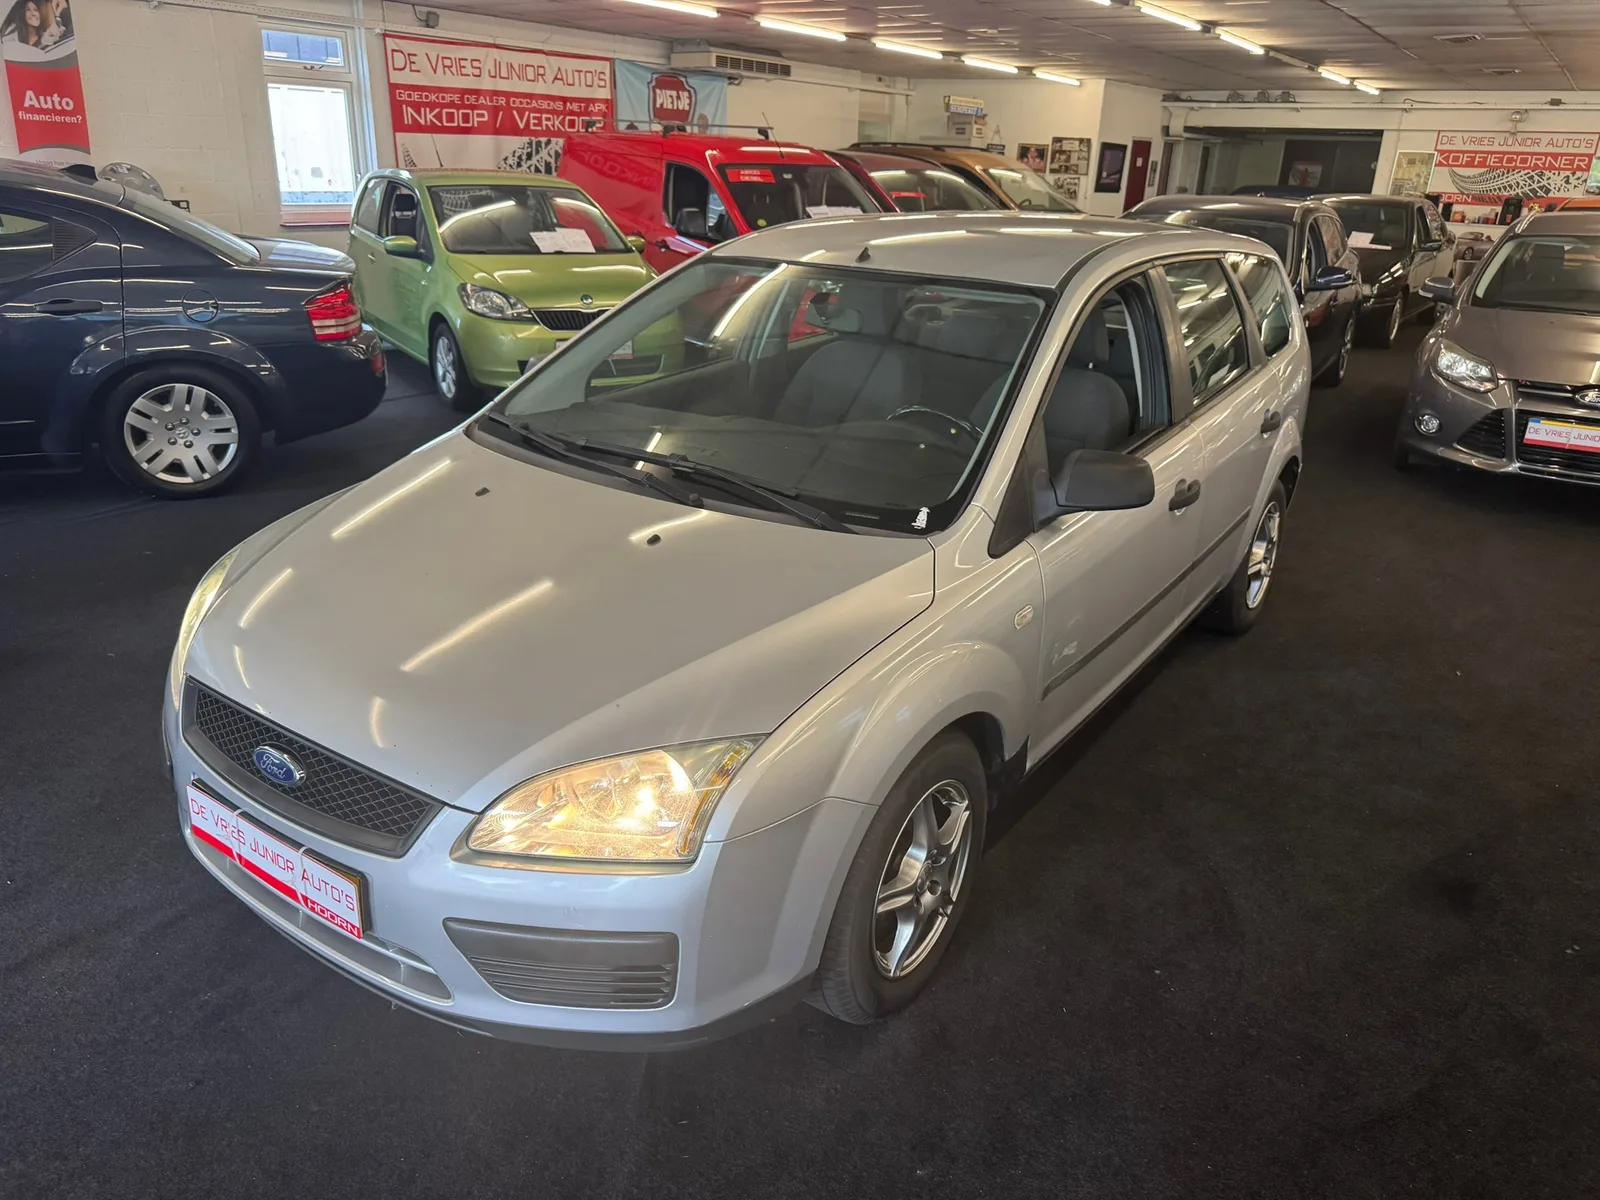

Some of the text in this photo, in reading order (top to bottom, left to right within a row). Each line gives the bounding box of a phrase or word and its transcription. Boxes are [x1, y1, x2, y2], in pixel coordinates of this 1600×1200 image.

[390, 48, 607, 88] DE VRIES JUNIOR AUTO'S
[24, 90, 74, 111] Auto
[396, 89, 461, 104] GOEDKOPE
[464, 94, 506, 107] DEALER
[566, 102, 586, 112] MET
[588, 102, 608, 113] APK
[655, 88, 690, 111] PIETJE
[18, 110, 82, 124] financieren?
[402, 104, 488, 127] INKOOP
[1440, 134, 1594, 149] DE VRIES JUNIOR AUTO'S
[1437, 152, 1589, 169] KOFFIECORNER
[1441, 193, 1472, 203] ORN
[1528, 426, 1600, 443] DE VRIES JUNIO
[260, 753, 287, 779] Ford
[191, 798, 355, 912] DE VRIES JUNIOR AUTO'S
[308, 899, 359, 937] HOORN
